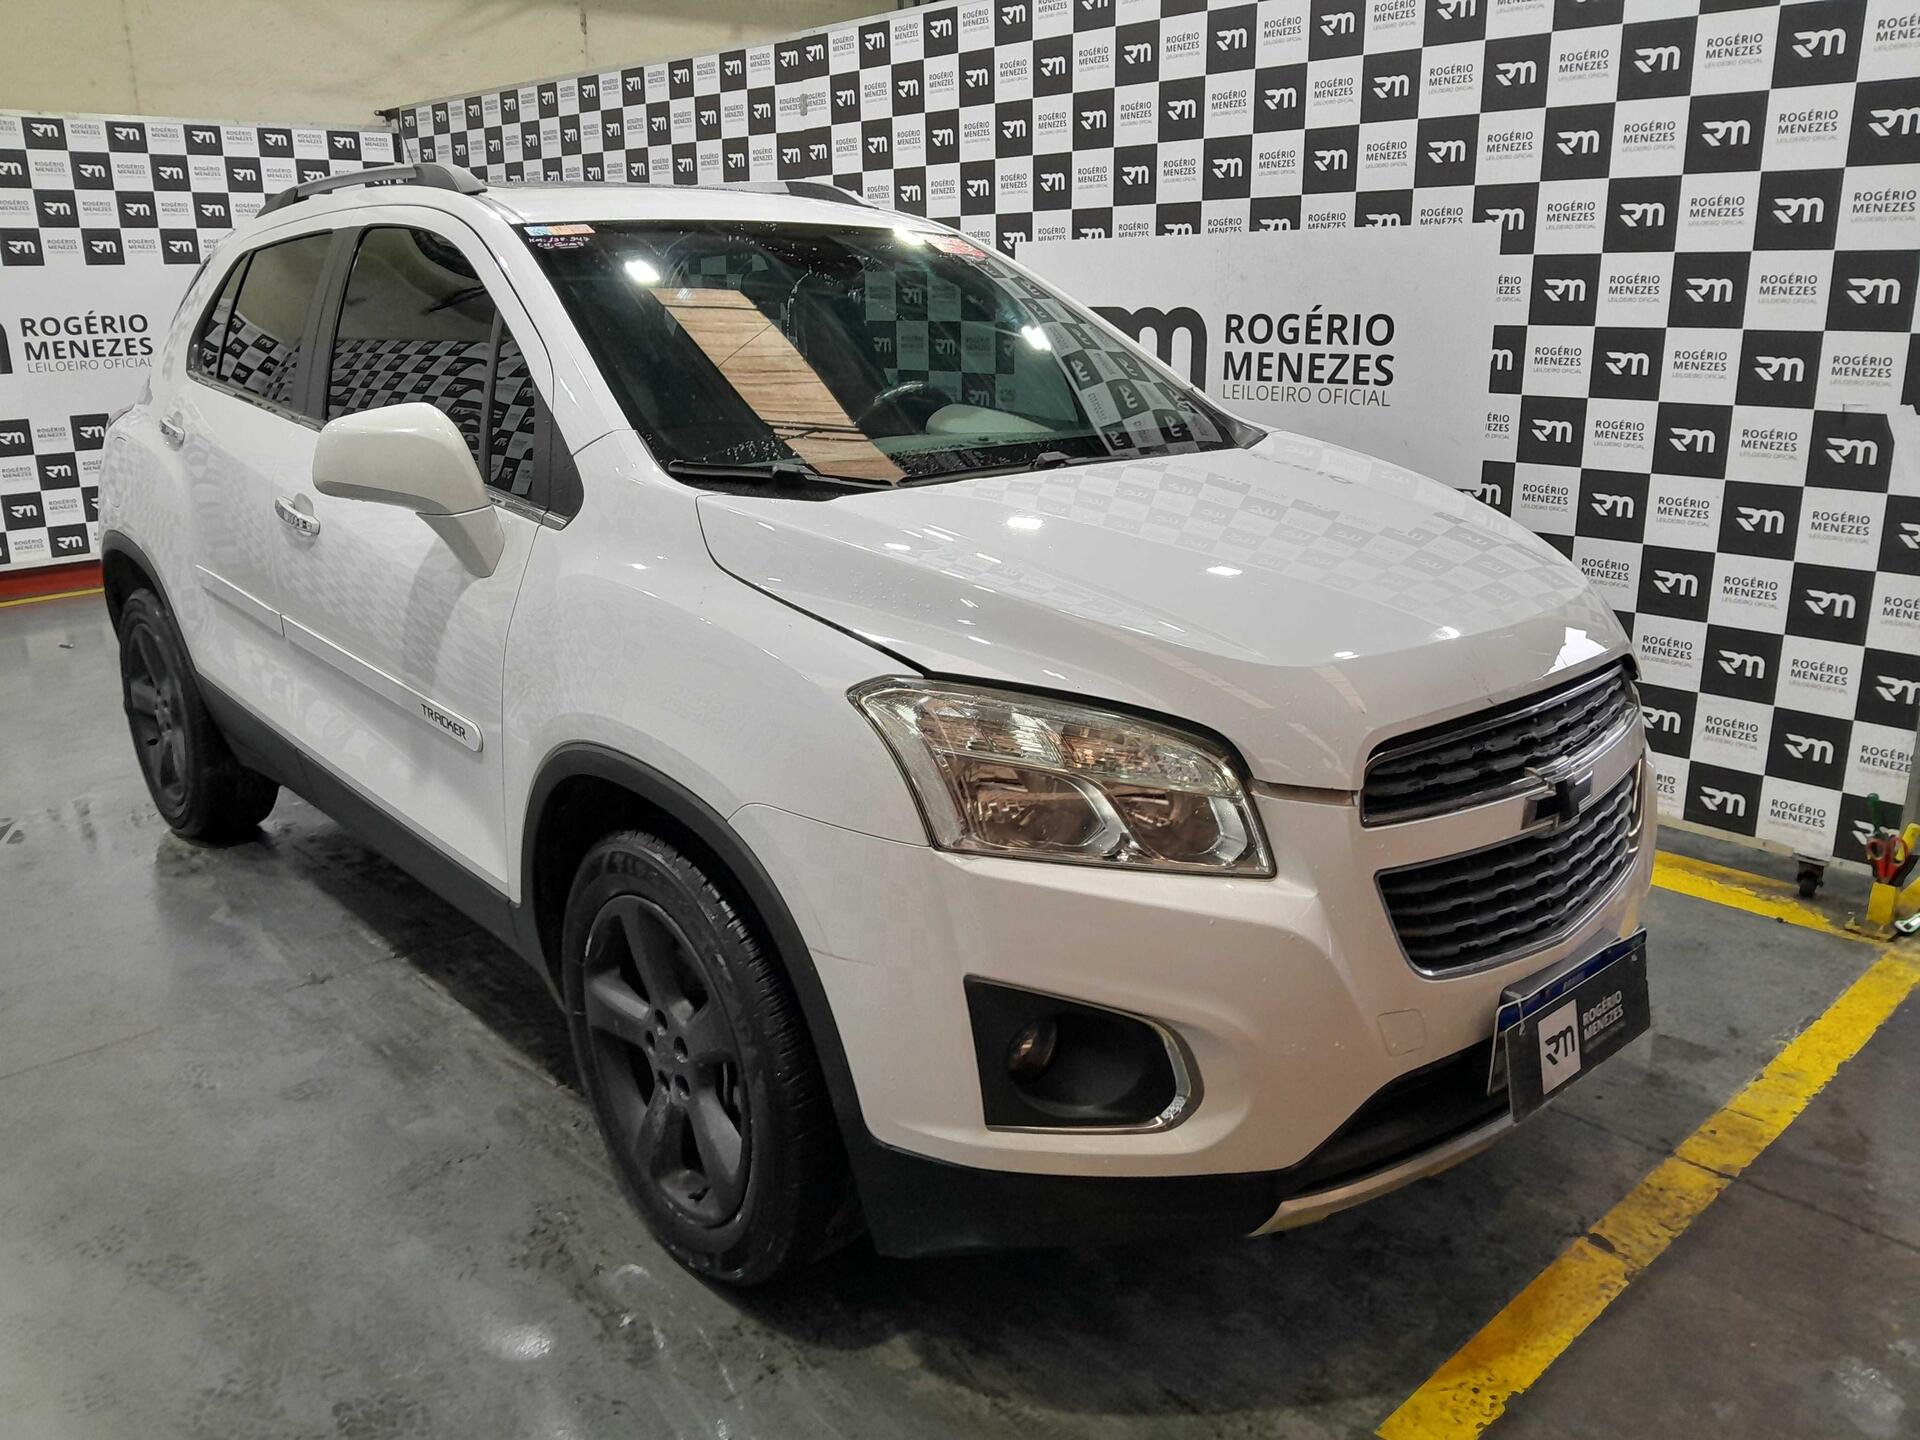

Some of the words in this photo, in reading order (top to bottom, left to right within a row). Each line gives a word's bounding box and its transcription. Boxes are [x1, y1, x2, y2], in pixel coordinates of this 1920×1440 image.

[1374, 9, 1415, 22] MENEZES
[1264, 16, 1301, 29] ROGÉRIO
[1878, 14, 1920, 30] ROGÉ
[1264, 25, 1301, 38] MENEZES
[1876, 28, 1920, 42] MENE
[1166, 32, 1199, 44] ROGÉRIO
[1707, 33, 1763, 48] ROGÉRIO
[1166, 41, 1200, 53] MENEZES
[1706, 44, 1762, 59] MENEZES
[1560, 49, 1609, 62] ROGÉRIO
[1430, 64, 1473, 76] ROGÉRIO
[1559, 60, 1608, 73] MENEZES
[1315, 77, 1353, 89] ROGÉRIO
[1429, 74, 1473, 86] MENEZES
[1212, 90, 1246, 101] ROGÉRIO
[1314, 87, 1353, 99] MENEZES
[1121, 101, 1151, 111] ROGÉRIO
[1212, 99, 1246, 110] MENEZES
[1120, 110, 1152, 120] MENEZES
[1779, 109, 1838, 123] ROGÉRIO
[1624, 120, 1675, 133] ROGÉRIO
[1778, 121, 1837, 134] MENEZES
[1488, 131, 1533, 142] ROGÉRIO
[1623, 132, 1675, 144] MENEZES
[1367, 141, 1407, 152] ROGÉRIO
[1487, 142, 1532, 152] MENEZES
[1259, 150, 1295, 160] ROGÉRIO
[1366, 151, 1407, 161] MENEZES
[1164, 158, 1196, 168] ROGÉRIO
[1259, 159, 1295, 170] MENEZES
[1163, 167, 1196, 177] MENEZES
[1691, 195, 1745, 207] ROGÉRIO
[1854, 188, 1916, 202] ROGÉRIO
[1421, 206, 1463, 217] ROGÉRIO
[1547, 200, 1595, 212] ROGÉRIO
[1852, 202, 1915, 213] MENEZES
[1308, 212, 1346, 222] ROGÉRIO
[1547, 212, 1595, 222] MENEZES
[1689, 207, 1744, 218] MENEZES
[1119, 222, 1149, 231] ROGÉRIO
[1208, 217, 1242, 226] ROGÉRIO
[1498, 274, 1521, 284] ÉRIO
[1610, 274, 1660, 284] ROGÉRIO
[1761, 274, 1817, 284] ROGÉRIO
[1496, 286, 1520, 294] EZES
[1609, 286, 1659, 294] MENEZES
[1759, 286, 1816, 296] MENEZES
[20, 310, 148, 337] ROGÉRIO
[1225, 304, 1395, 346] ROGÉRIO
[24, 337, 153, 361] MENEZES
[1535, 346, 1582, 356] ROGÉRIO
[1674, 349, 1727, 361] ROGÉRIO
[1534, 357, 1581, 366] MENEZES
[1673, 361, 1726, 371] MENEZES
[1833, 354, 1892, 366] ROGÉRIO
[27, 360, 99, 373] LEILOEIRO
[1223, 351, 1394, 386] MENEZES
[1831, 367, 1892, 378] MENEZES
[1222, 383, 1311, 403] LEILOEIRO
[1318, 387, 1391, 407] OFICIAL
[1487, 412, 1509, 423] ÉRIO
[1485, 423, 1509, 432] EZES
[1596, 420, 1644, 431] ROGÉRIO
[1595, 430, 1644, 441] MENEZES
[1742, 429, 1798, 441] ROGÉRIO
[1741, 440, 1796, 452] MENEZES
[1523, 484, 1568, 495] ROGÉRIO
[1522, 493, 1568, 506] MENEZES
[1658, 496, 1710, 509] ROGÉRIO
[1657, 506, 1709, 520] MENEZES
[1812, 511, 1870, 525] ROGÉRIO
[1811, 522, 1869, 536] MENEZES
[1582, 558, 1629, 571] ROGÉRIO
[1581, 567, 1628, 582] MENEZES
[1724, 576, 1778, 590] ROGÉRIO
[1723, 586, 1777, 600] MENEZES
[1643, 635, 1692, 650] ROGÉRIO
[1642, 644, 1692, 661] MENEZES
[1792, 659, 1848, 675] ROGÉRIO
[1790, 669, 1847, 686] MENEZES
[421, 703, 467, 740] TRACKER
[1706, 716, 1758, 732] ROGÉRIO
[1705, 725, 1757, 743] MENEZES
[1860, 755, 1911, 773] MENEZE
[1772, 799, 1826, 818] ROGÉRIO
[1770, 809, 1825, 828] MENEZES
